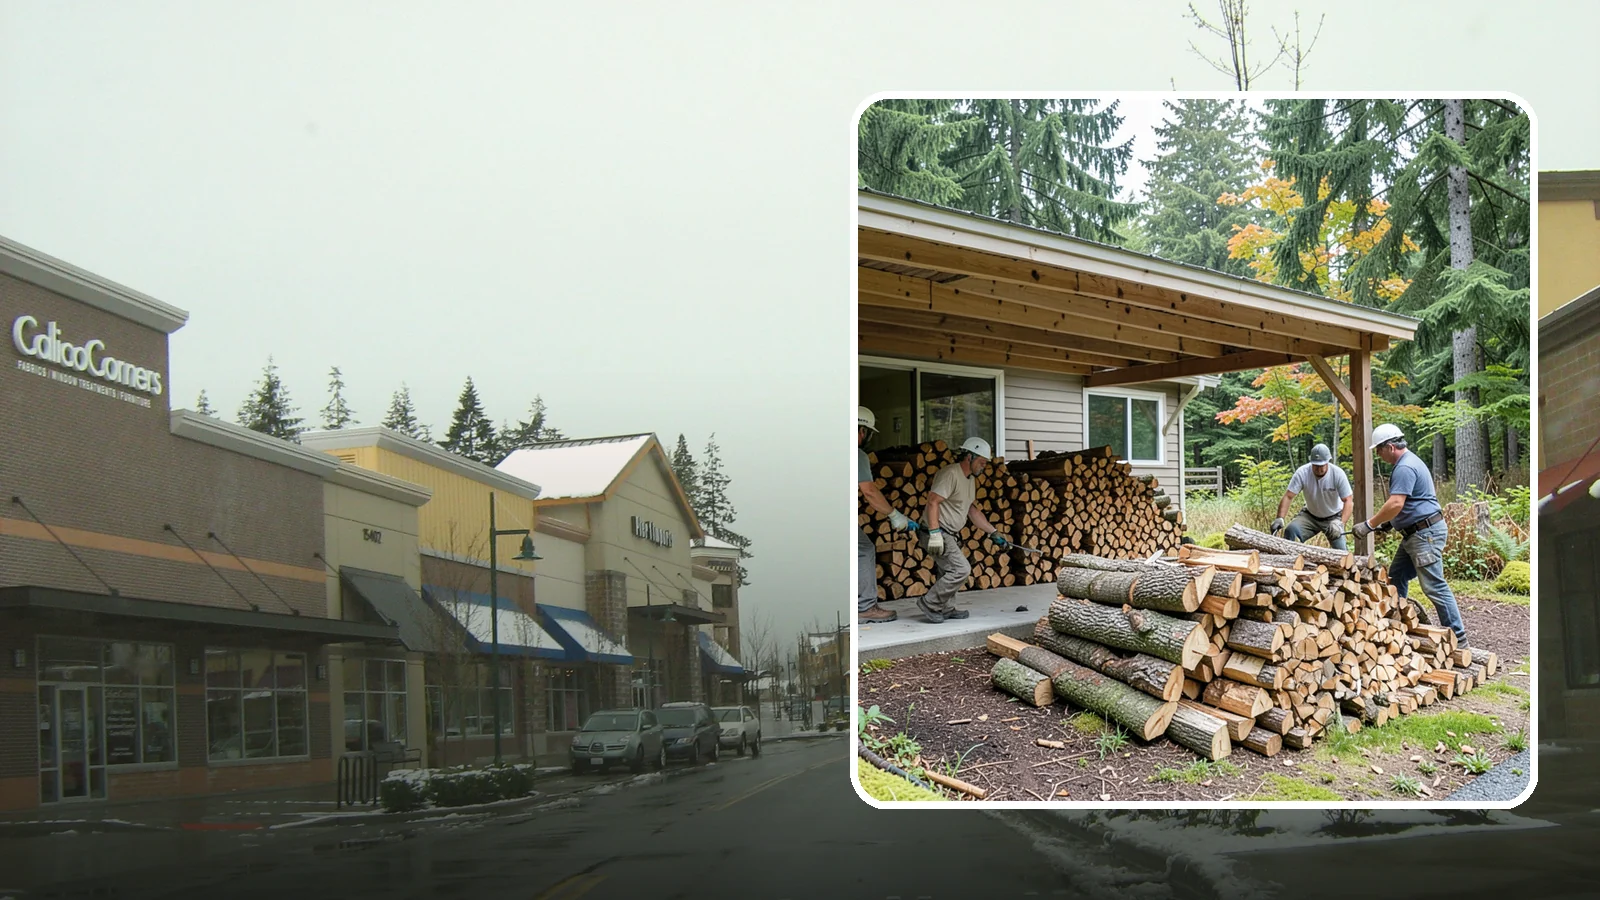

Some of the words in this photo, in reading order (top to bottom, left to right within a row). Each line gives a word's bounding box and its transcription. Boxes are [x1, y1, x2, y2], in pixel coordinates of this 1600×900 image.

[12, 315, 162, 396] CalicoCorners
[17, 360, 47, 377] FABRICS
[51, 370, 78, 386] WINDOW
[78, 378, 117, 398] TREATMENTS
[120, 391, 151, 408] FURNITURE
